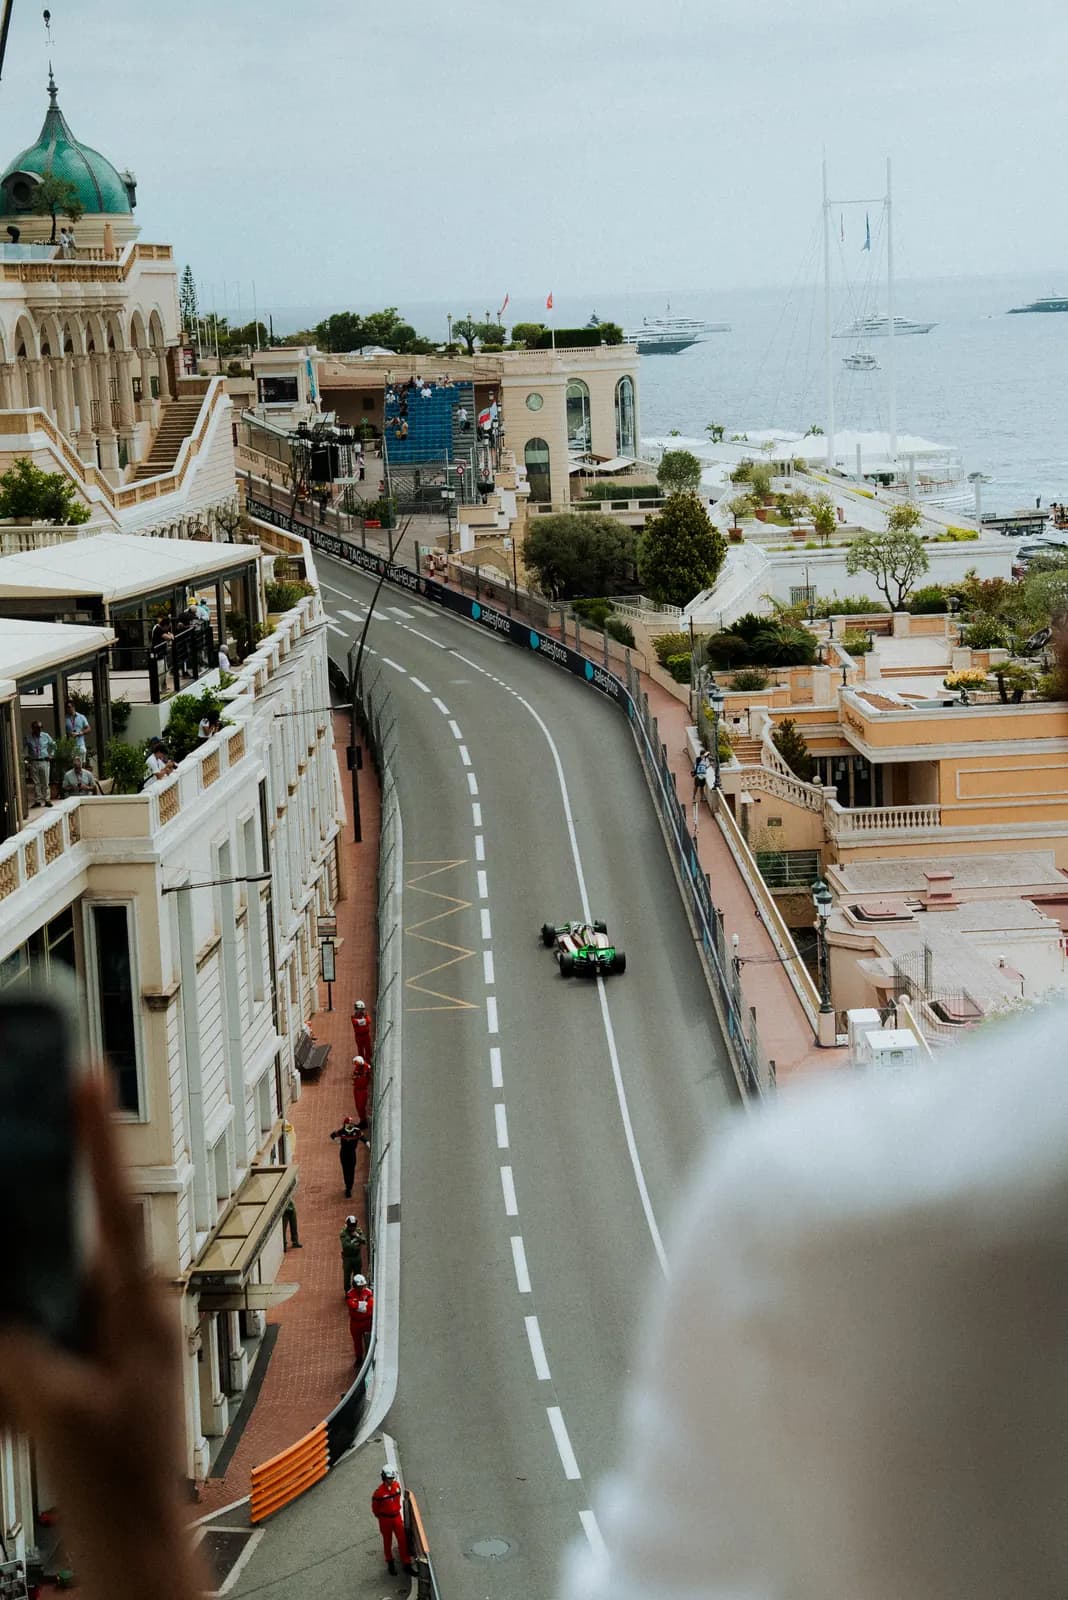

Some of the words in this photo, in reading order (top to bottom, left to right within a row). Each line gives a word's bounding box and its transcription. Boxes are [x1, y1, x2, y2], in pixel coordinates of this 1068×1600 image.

[481, 609, 510, 632] salesforce
[539, 639, 568, 662] salesforce
[593, 669, 618, 697] salesforce
